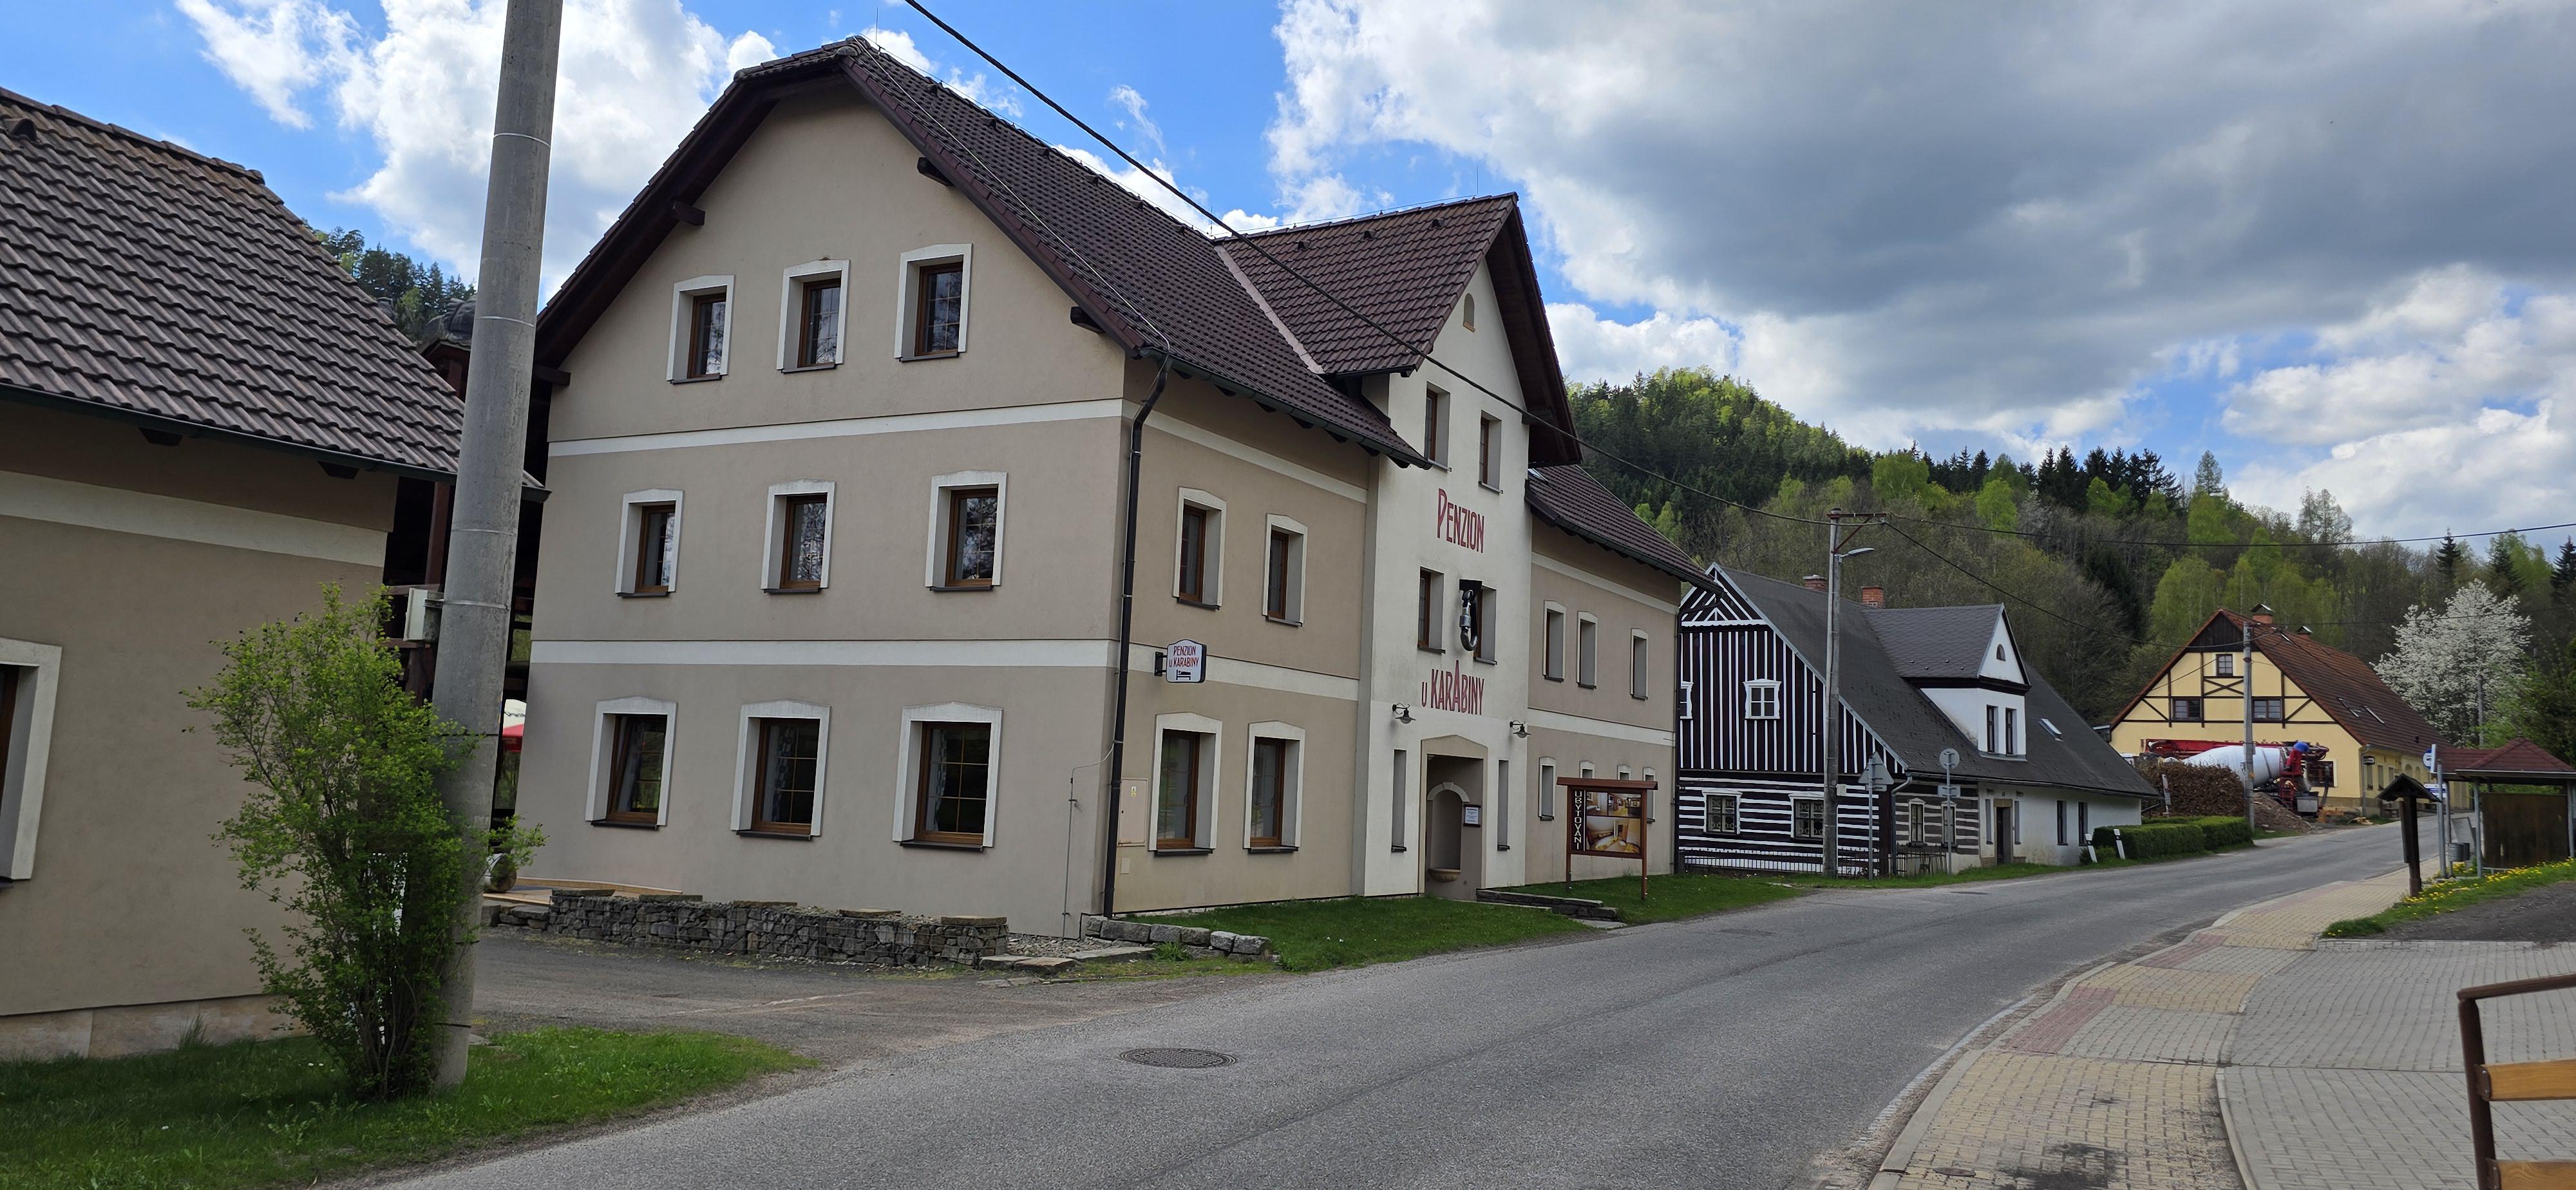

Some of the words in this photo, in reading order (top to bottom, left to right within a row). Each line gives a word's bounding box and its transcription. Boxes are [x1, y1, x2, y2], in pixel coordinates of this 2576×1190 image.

[1173, 645, 1197, 656] PENZION
[1173, 657, 1199, 667] KARABINY
[1430, 659, 1484, 715] KARABINY
